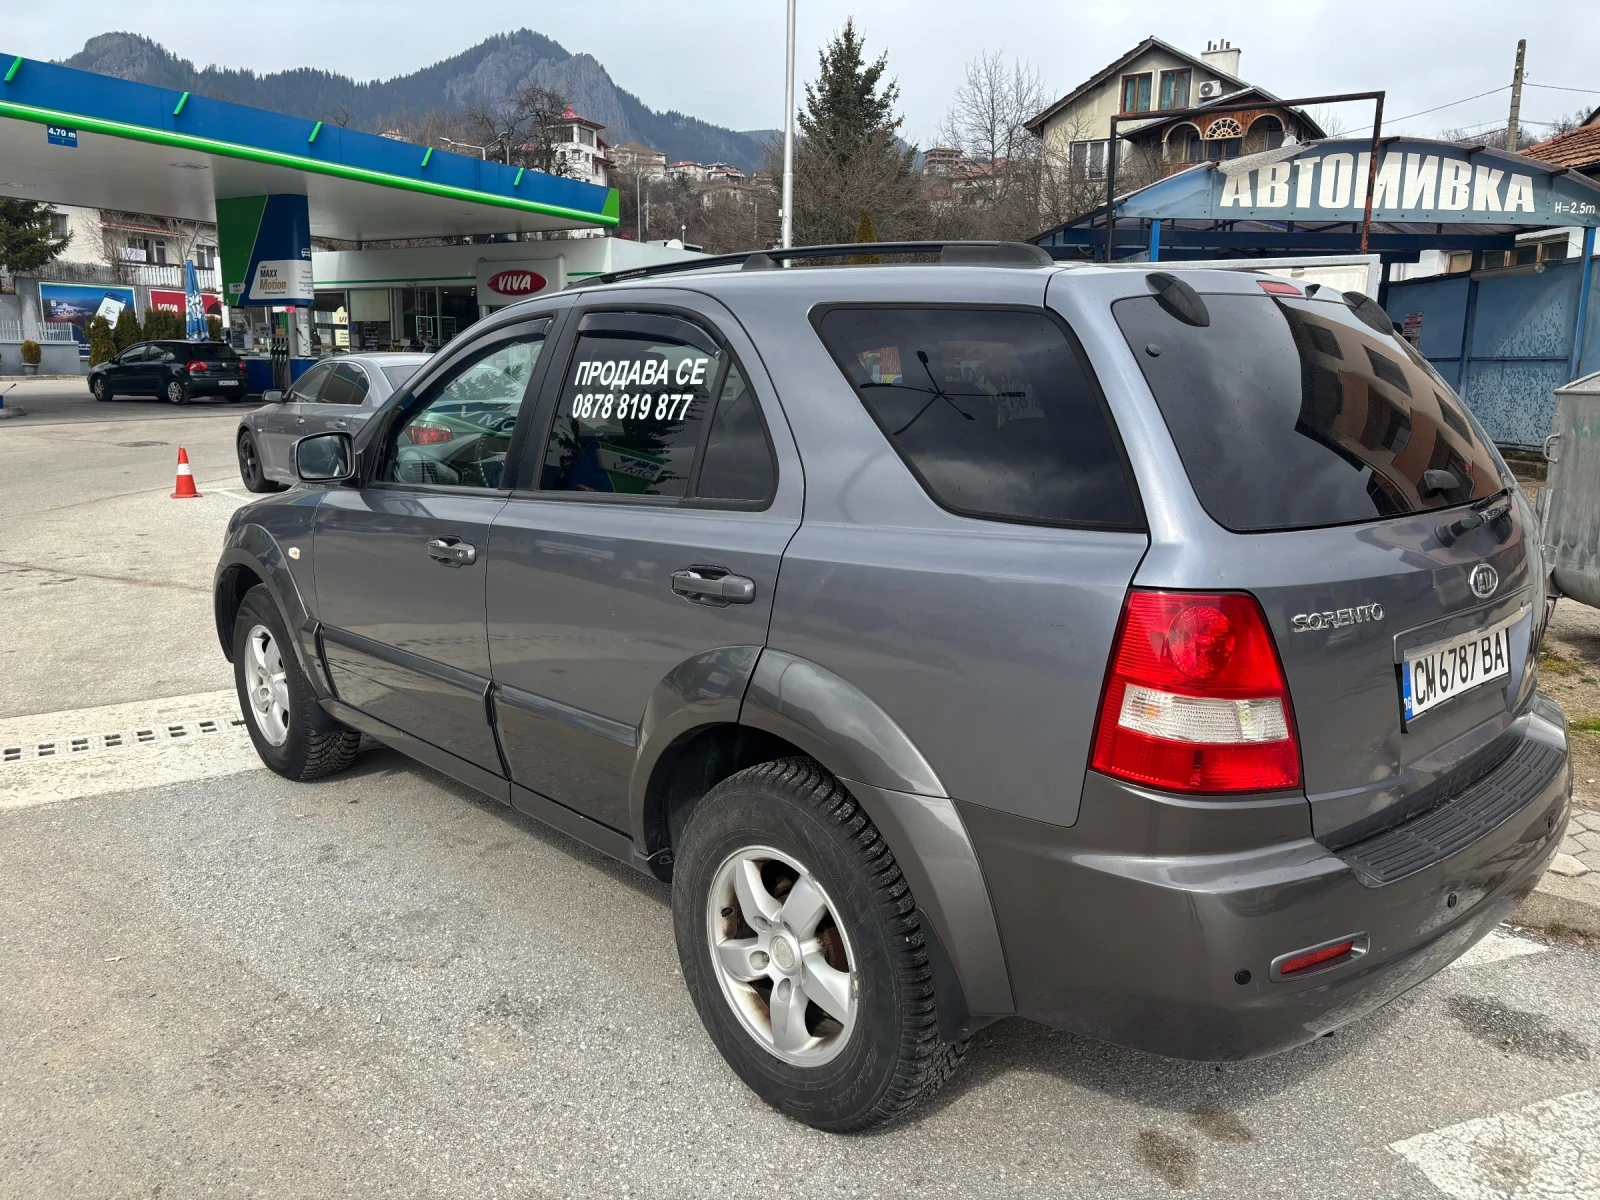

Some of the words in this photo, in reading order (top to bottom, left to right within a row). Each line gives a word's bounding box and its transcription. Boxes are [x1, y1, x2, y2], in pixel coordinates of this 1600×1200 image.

[48, 127, 67, 137] 4.70
[1220, 152, 1535, 213] АВТОМИВКА
[259, 269, 278, 278] MAXX
[259, 279, 287, 290] Motion
[498, 274, 532, 292] VIVA
[157, 303, 179, 313] VIVA
[574, 359, 669, 390] ПРОДАВА
[675, 358, 709, 385] СЕ
[572, 393, 614, 419] 0878
[616, 393, 652, 420] 819
[654, 394, 694, 421] 877
[1290, 602, 1386, 633] SORENTO
